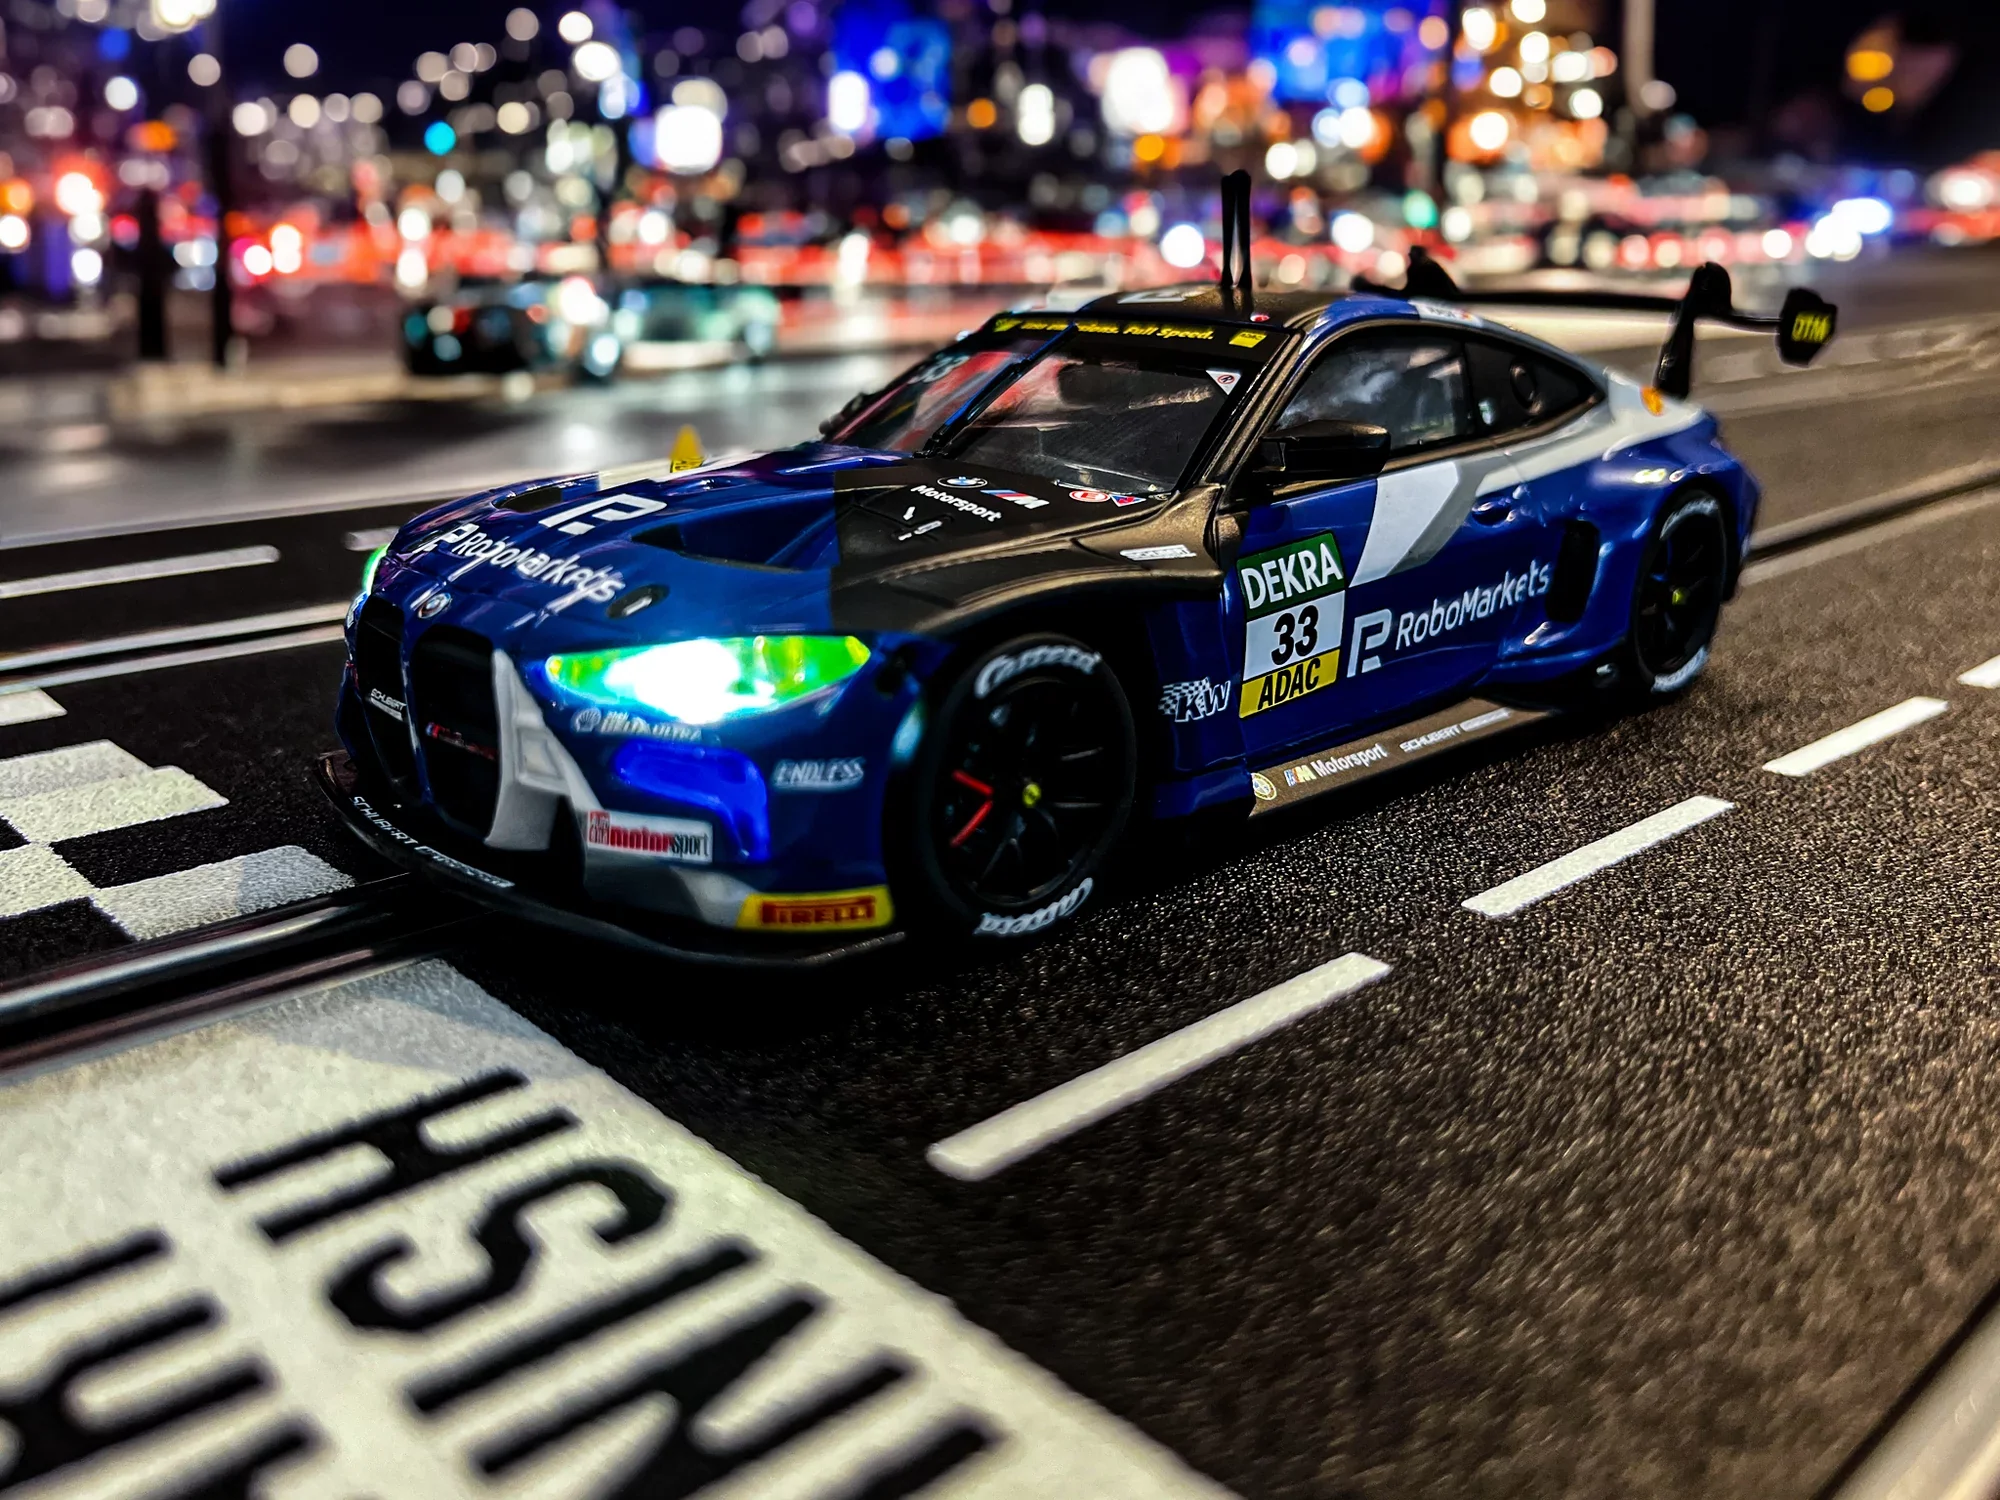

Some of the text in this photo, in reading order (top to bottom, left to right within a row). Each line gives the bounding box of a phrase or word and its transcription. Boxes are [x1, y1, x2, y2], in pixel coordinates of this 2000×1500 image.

[909, 484, 1002, 523] Motorsport
[1241, 542, 1343, 610] DEKRA
[1396, 559, 1550, 650] RoboMarkets
[1270, 605, 1319, 665] 33
[1175, 680, 1231, 722] KW
[1258, 658, 1320, 710] ADAC
[1399, 724, 1462, 753] SCHUBERT
[774, 757, 865, 786] ENDLESS
[1315, 744, 1387, 777] Motorsport
[762, 896, 876, 926] PIRELLI
